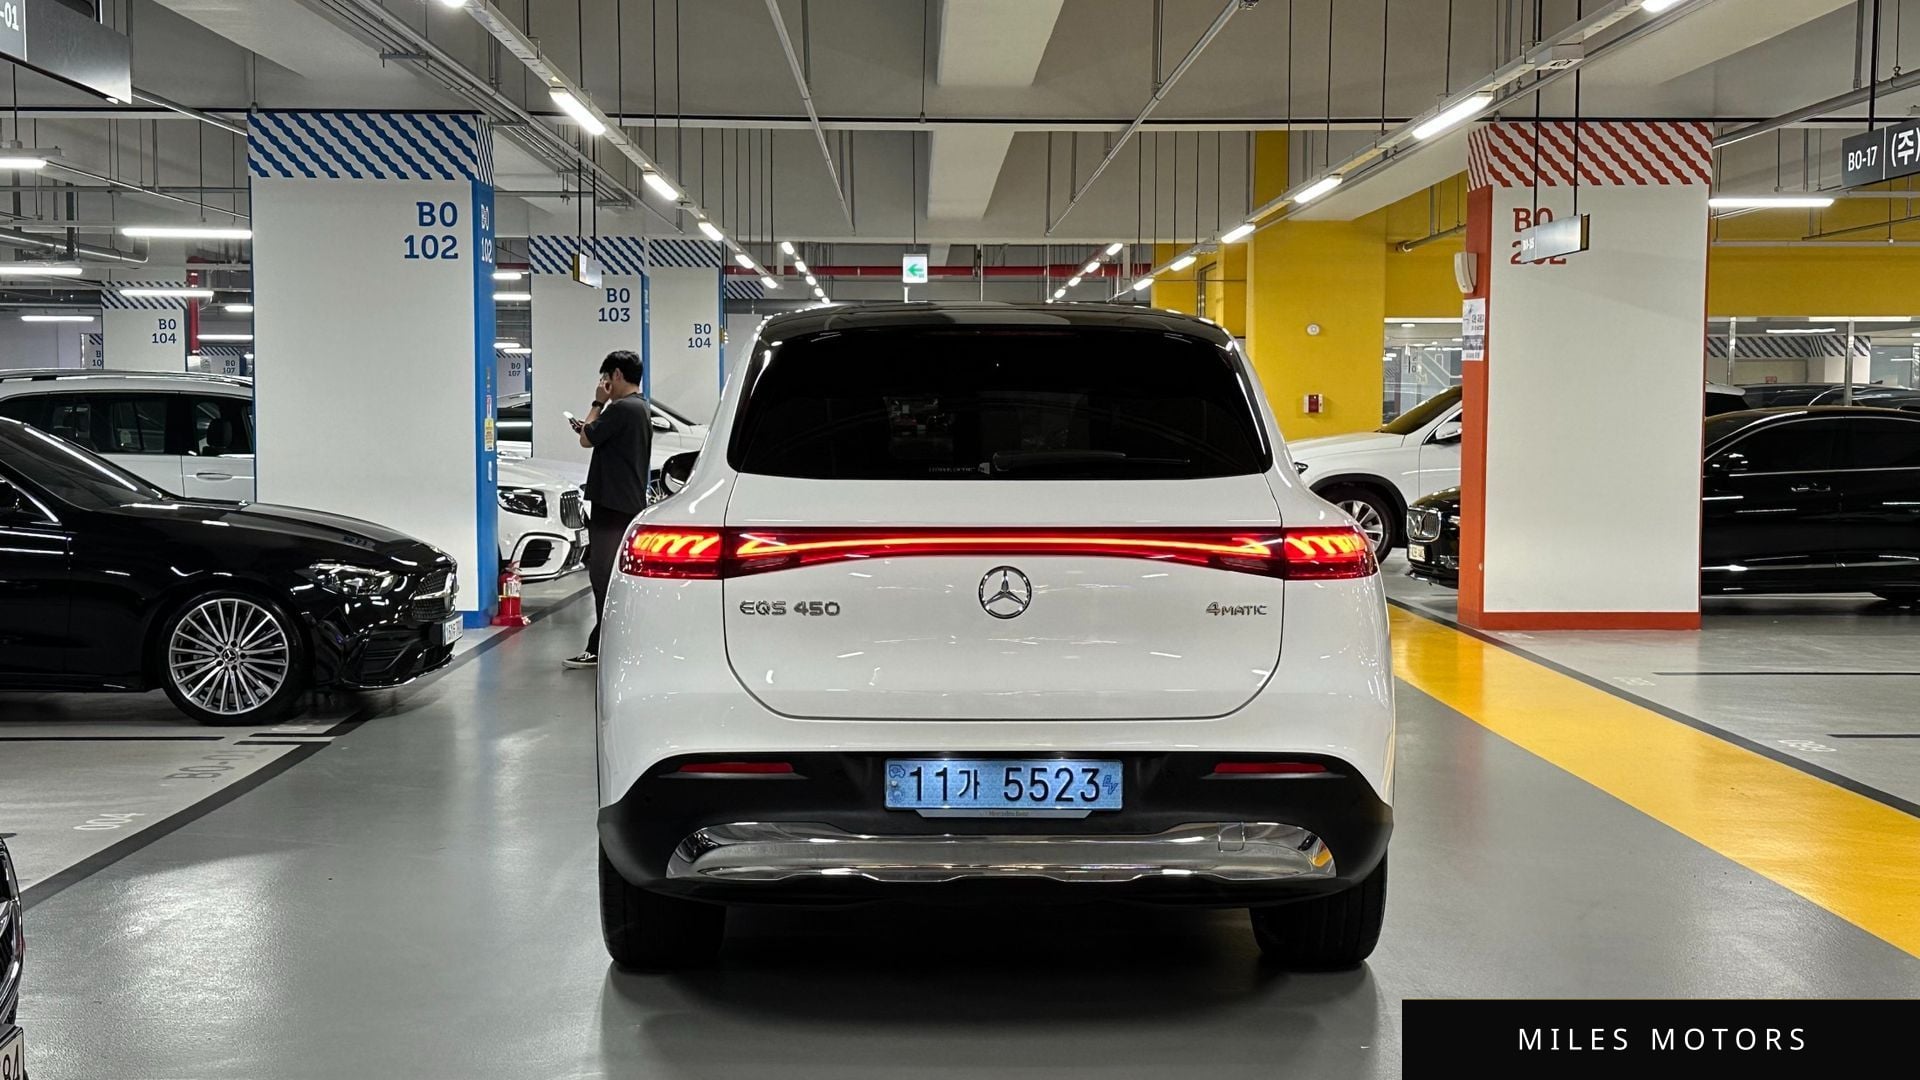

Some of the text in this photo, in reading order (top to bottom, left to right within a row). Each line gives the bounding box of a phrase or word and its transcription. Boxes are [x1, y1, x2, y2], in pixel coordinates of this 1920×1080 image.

[1891, 127, 1920, 168] (주)
[404, 234, 459, 259] 102
[598, 307, 631, 322] 103
[151, 333, 177, 344] 104
[687, 337, 712, 348] 104
[740, 601, 840, 616] EQS 450
[1206, 601, 1267, 616] 4MATIC
[909, 765, 1100, 802] 11가 5523
